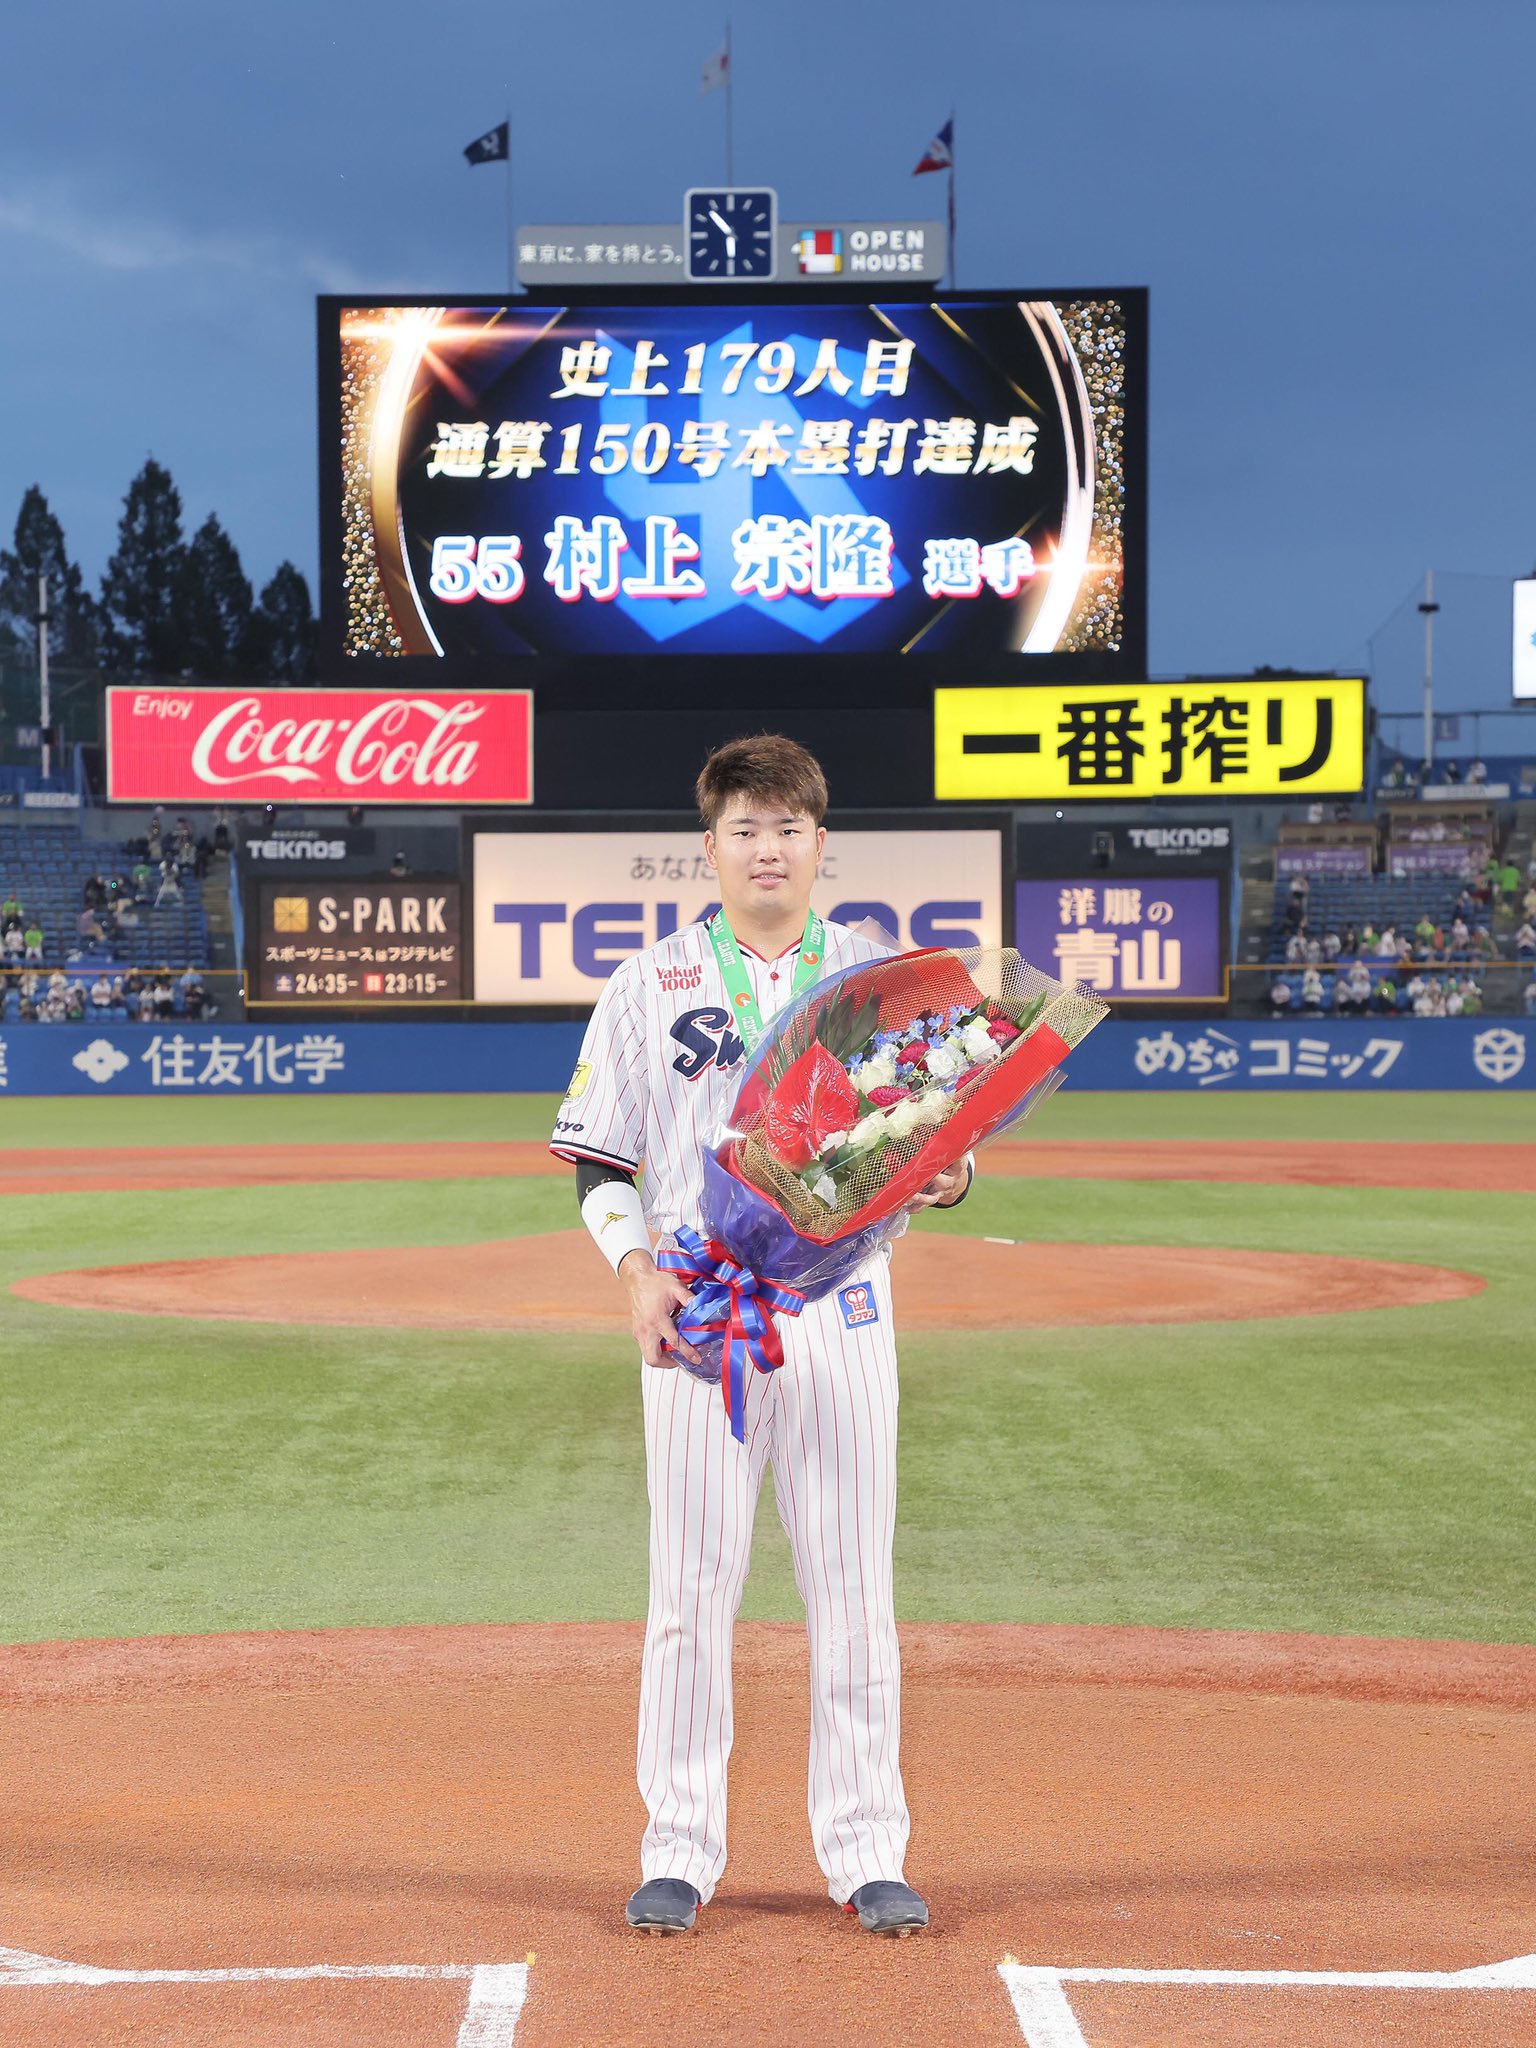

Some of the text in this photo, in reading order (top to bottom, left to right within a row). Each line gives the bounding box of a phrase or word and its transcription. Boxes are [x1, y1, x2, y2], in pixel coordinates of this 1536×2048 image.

[518, 243, 684, 265] 東京に、家を持とう。
[850, 230, 925, 251] OPEN
[850, 253, 924, 271] HOUSE
[549, 338, 917, 399] 史上179人目
[426, 416, 1040, 480] 通算150号本塁打達成
[430, 513, 1036, 602] 55 村上 宗隆 選手
[132, 694, 194, 720] Enjoy
[191, 698, 488, 785] Coca-Cola
[962, 696, 1334, 785] 一番搾り
[246, 839, 347, 859] TEKNOS
[1128, 827, 1230, 848] TEKNOS
[318, 897, 448, 933] S-PARK
[1059, 887, 1174, 925] 洋服の
[656, 963, 703, 980] Yakult
[1052, 928, 1181, 990] 青山
[659, 976, 701, 993] 1000
[142, 1034, 346, 1087] 住友化学
[1134, 1028, 1404, 1084] めちゃコミック
[848, 1309, 875, 1323] タフマン
